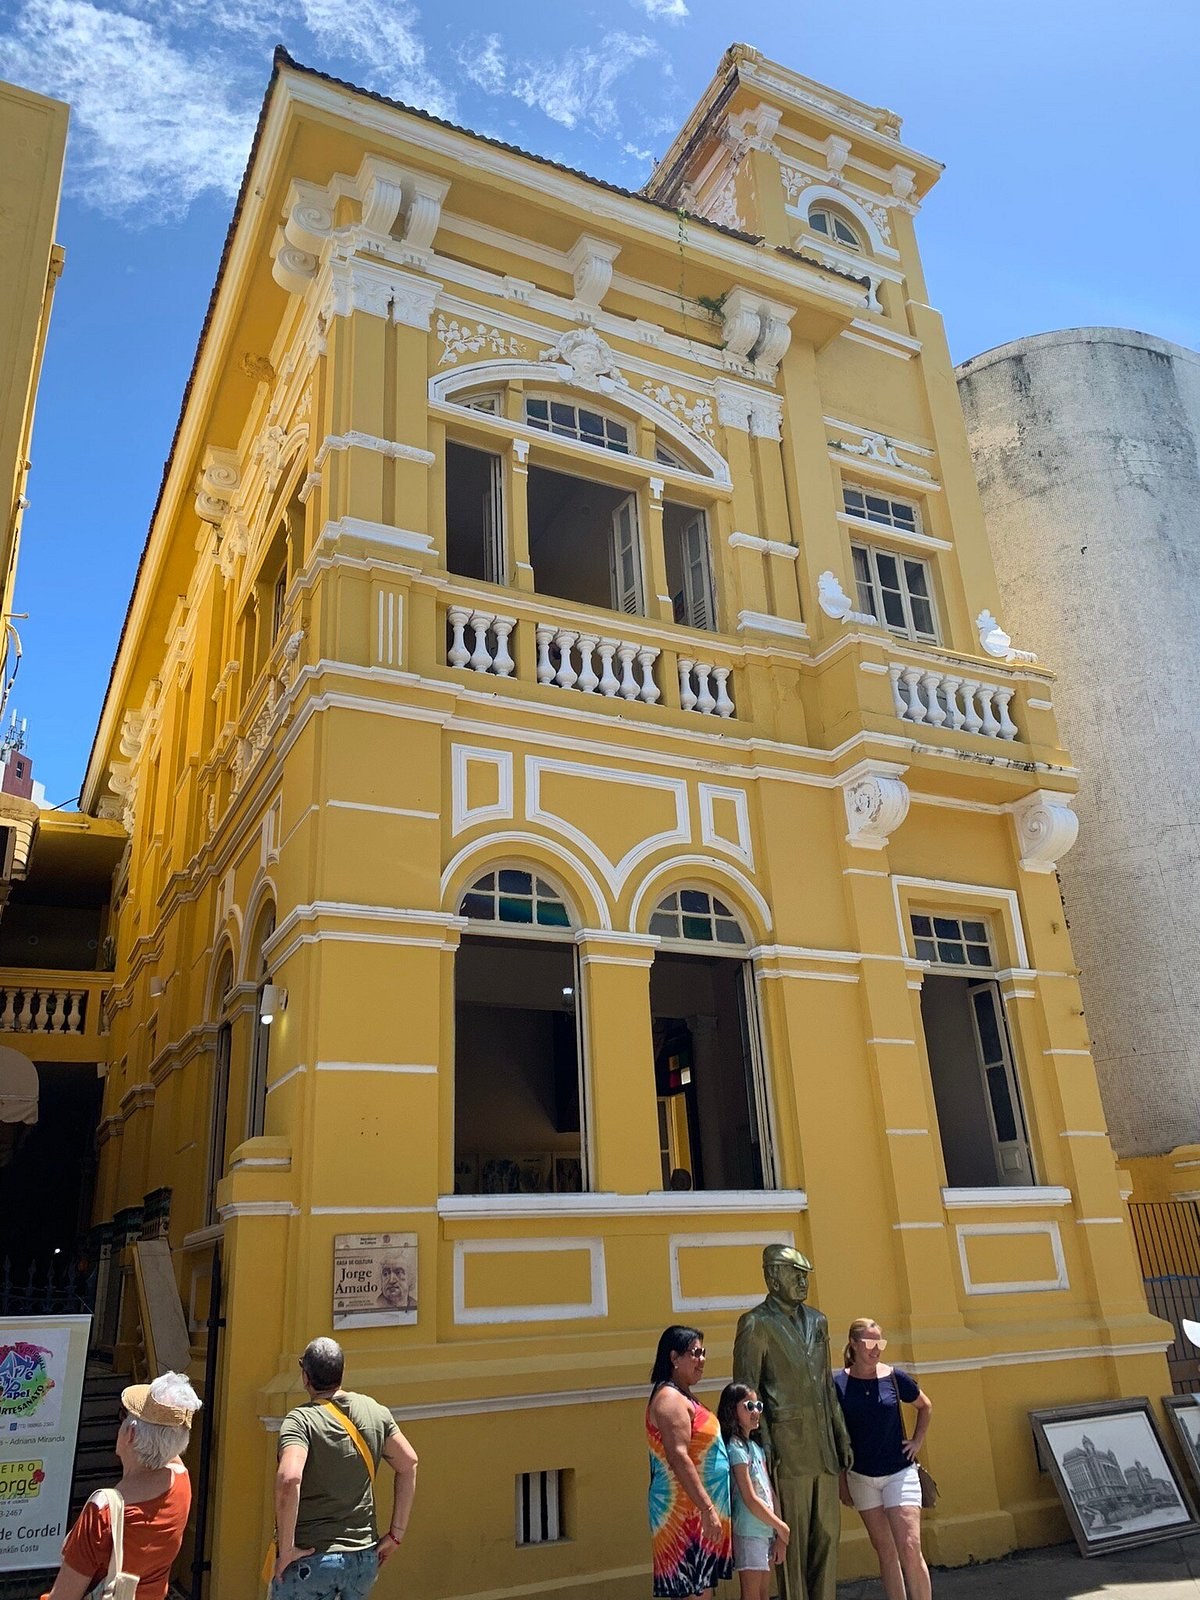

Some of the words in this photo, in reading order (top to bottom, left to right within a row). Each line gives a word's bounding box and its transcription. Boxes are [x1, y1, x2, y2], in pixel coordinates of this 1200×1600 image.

[340, 1268, 372, 1283] Jorge
[335, 1281, 378, 1294] Amado
[9, 1437, 36, 1446] Adriana
[37, 1434, 65, 1444] Miranda
[17, 1522, 61, 1539] Cordel
[20, 1544, 39, 1553] Costa
